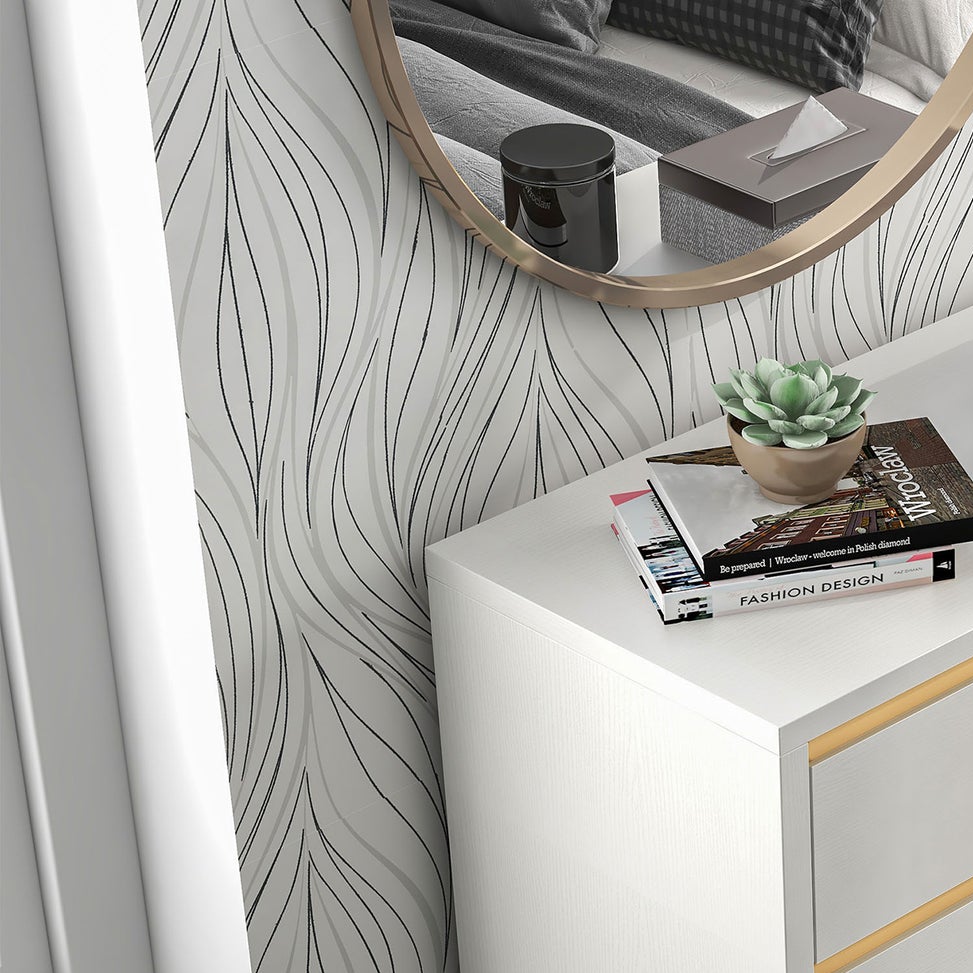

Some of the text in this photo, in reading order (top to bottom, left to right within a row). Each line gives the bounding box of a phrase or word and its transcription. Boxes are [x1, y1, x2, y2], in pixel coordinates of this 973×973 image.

[870, 445, 937, 522] Wroclaw
[720, 564, 730, 574] Be
[731, 558, 766, 573] prepared
[774, 552, 808, 565] Wroclaw
[812, 548, 846, 560] welcome
[847, 545, 855, 554] in
[855, 542, 877, 553] Polish
[877, 537, 911, 550] diamond
[740, 585, 815, 606] FASHION
[821, 573, 884, 592] DESIGN
